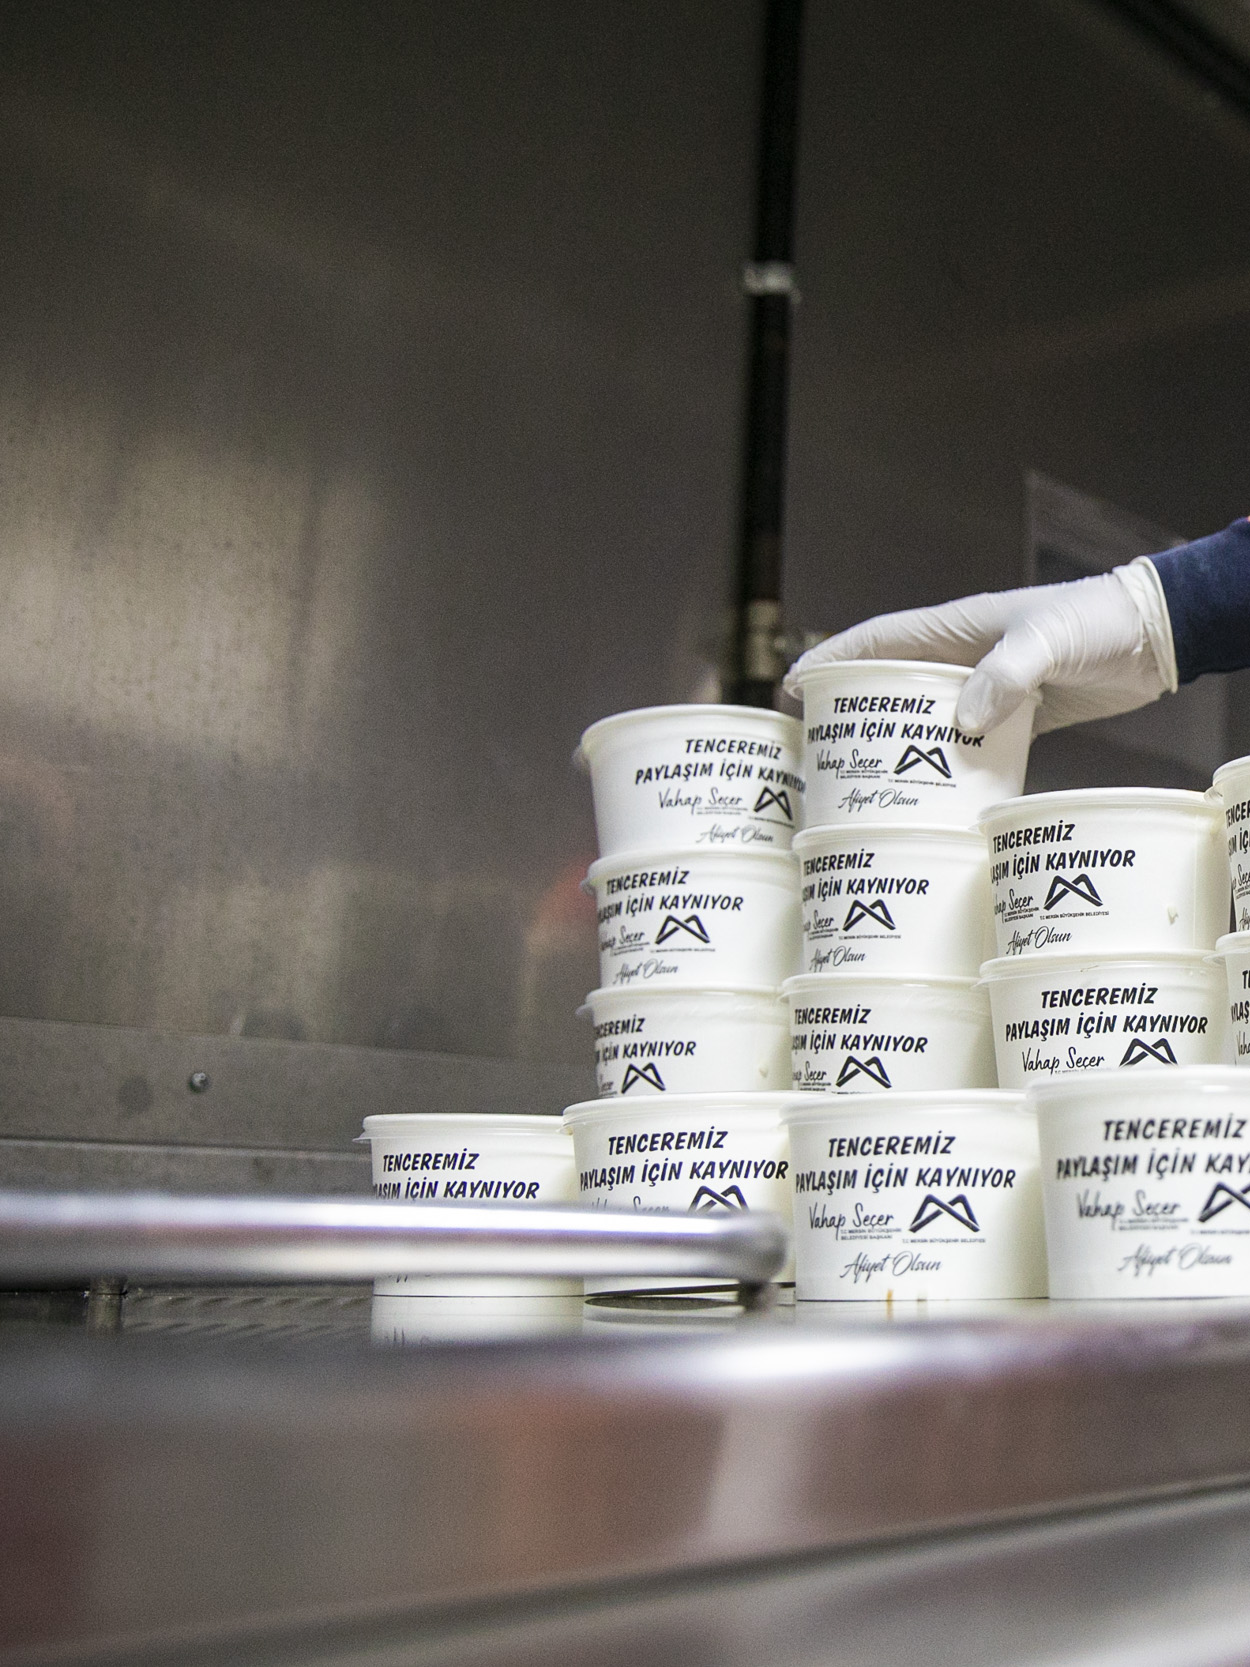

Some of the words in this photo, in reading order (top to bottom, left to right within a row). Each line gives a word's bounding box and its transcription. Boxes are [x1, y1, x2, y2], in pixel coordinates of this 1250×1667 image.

[834, 694, 936, 714] TENCEREMİZ
[860, 718, 895, 742] İÇİN
[685, 739, 782, 760] TENCEREMİZ
[849, 748, 883, 771] Seçer
[635, 762, 714, 785] PAYLAŞIM
[719, 758, 753, 781] İÇİN
[658, 788, 702, 815] Vahap
[708, 787, 743, 806] Seçer
[879, 787, 919, 809] Olsun
[992, 819, 1076, 854] TENCEREMİZ
[804, 848, 875, 876] TENCEREMİZ
[1012, 851, 1041, 880] İÇİN
[1045, 849, 1136, 870] KAYNIYOR
[606, 866, 690, 896] TENCEREMİZ
[818, 876, 843, 903] İÇİN
[846, 877, 930, 895] KAYNIYOR
[626, 893, 654, 917] İÇİN
[659, 893, 744, 911] KAYNIYOR
[1009, 888, 1034, 912] Seçer
[813, 910, 835, 931] Seçer
[1006, 929, 1035, 955] Afiyet
[1034, 926, 1073, 949] Olsun
[1041, 982, 1158, 1009] TENCEREMİZ
[794, 1004, 872, 1025] TENCEREMİZ
[1005, 1017, 1071, 1041] PAYLAŞIM
[1076, 1011, 1117, 1038] İÇİN
[1122, 1013, 1208, 1034] KAYNIYOR
[622, 1041, 697, 1059] KAYNIYOR
[810, 1030, 836, 1054] İÇİN
[840, 1033, 928, 1053] KAYNIYOR
[804, 1061, 827, 1082] Seçer
[1021, 1046, 1060, 1074] Vahap
[1065, 1046, 1105, 1070] Seçer
[608, 1126, 728, 1155] TENCEREMİZ
[1104, 1113, 1248, 1141] TENCEREMİZ
[828, 1130, 956, 1158] TENCEREMİZ
[383, 1148, 480, 1172] TENCEREMİZ
[1057, 1155, 1138, 1182] PAYLAŞIM
[1147, 1148, 1196, 1180] İÇİN
[580, 1165, 635, 1191] PAYLAŞIM
[641, 1158, 683, 1187] İÇİN
[689, 1159, 789, 1180] KAYNIYOR
[795, 1169, 858, 1195] PAYLAŞIM
[864, 1163, 909, 1193] İÇİN
[915, 1166, 1016, 1188] KAYNIYOR
[443, 1180, 540, 1199] KAYNIYOR
[1132, 1189, 1181, 1217] Seçer
[809, 1202, 846, 1241] Vahap
[852, 1202, 894, 1228] Seçer
[839, 1251, 890, 1284] Afiyet
[892, 1250, 942, 1277] Olsun
